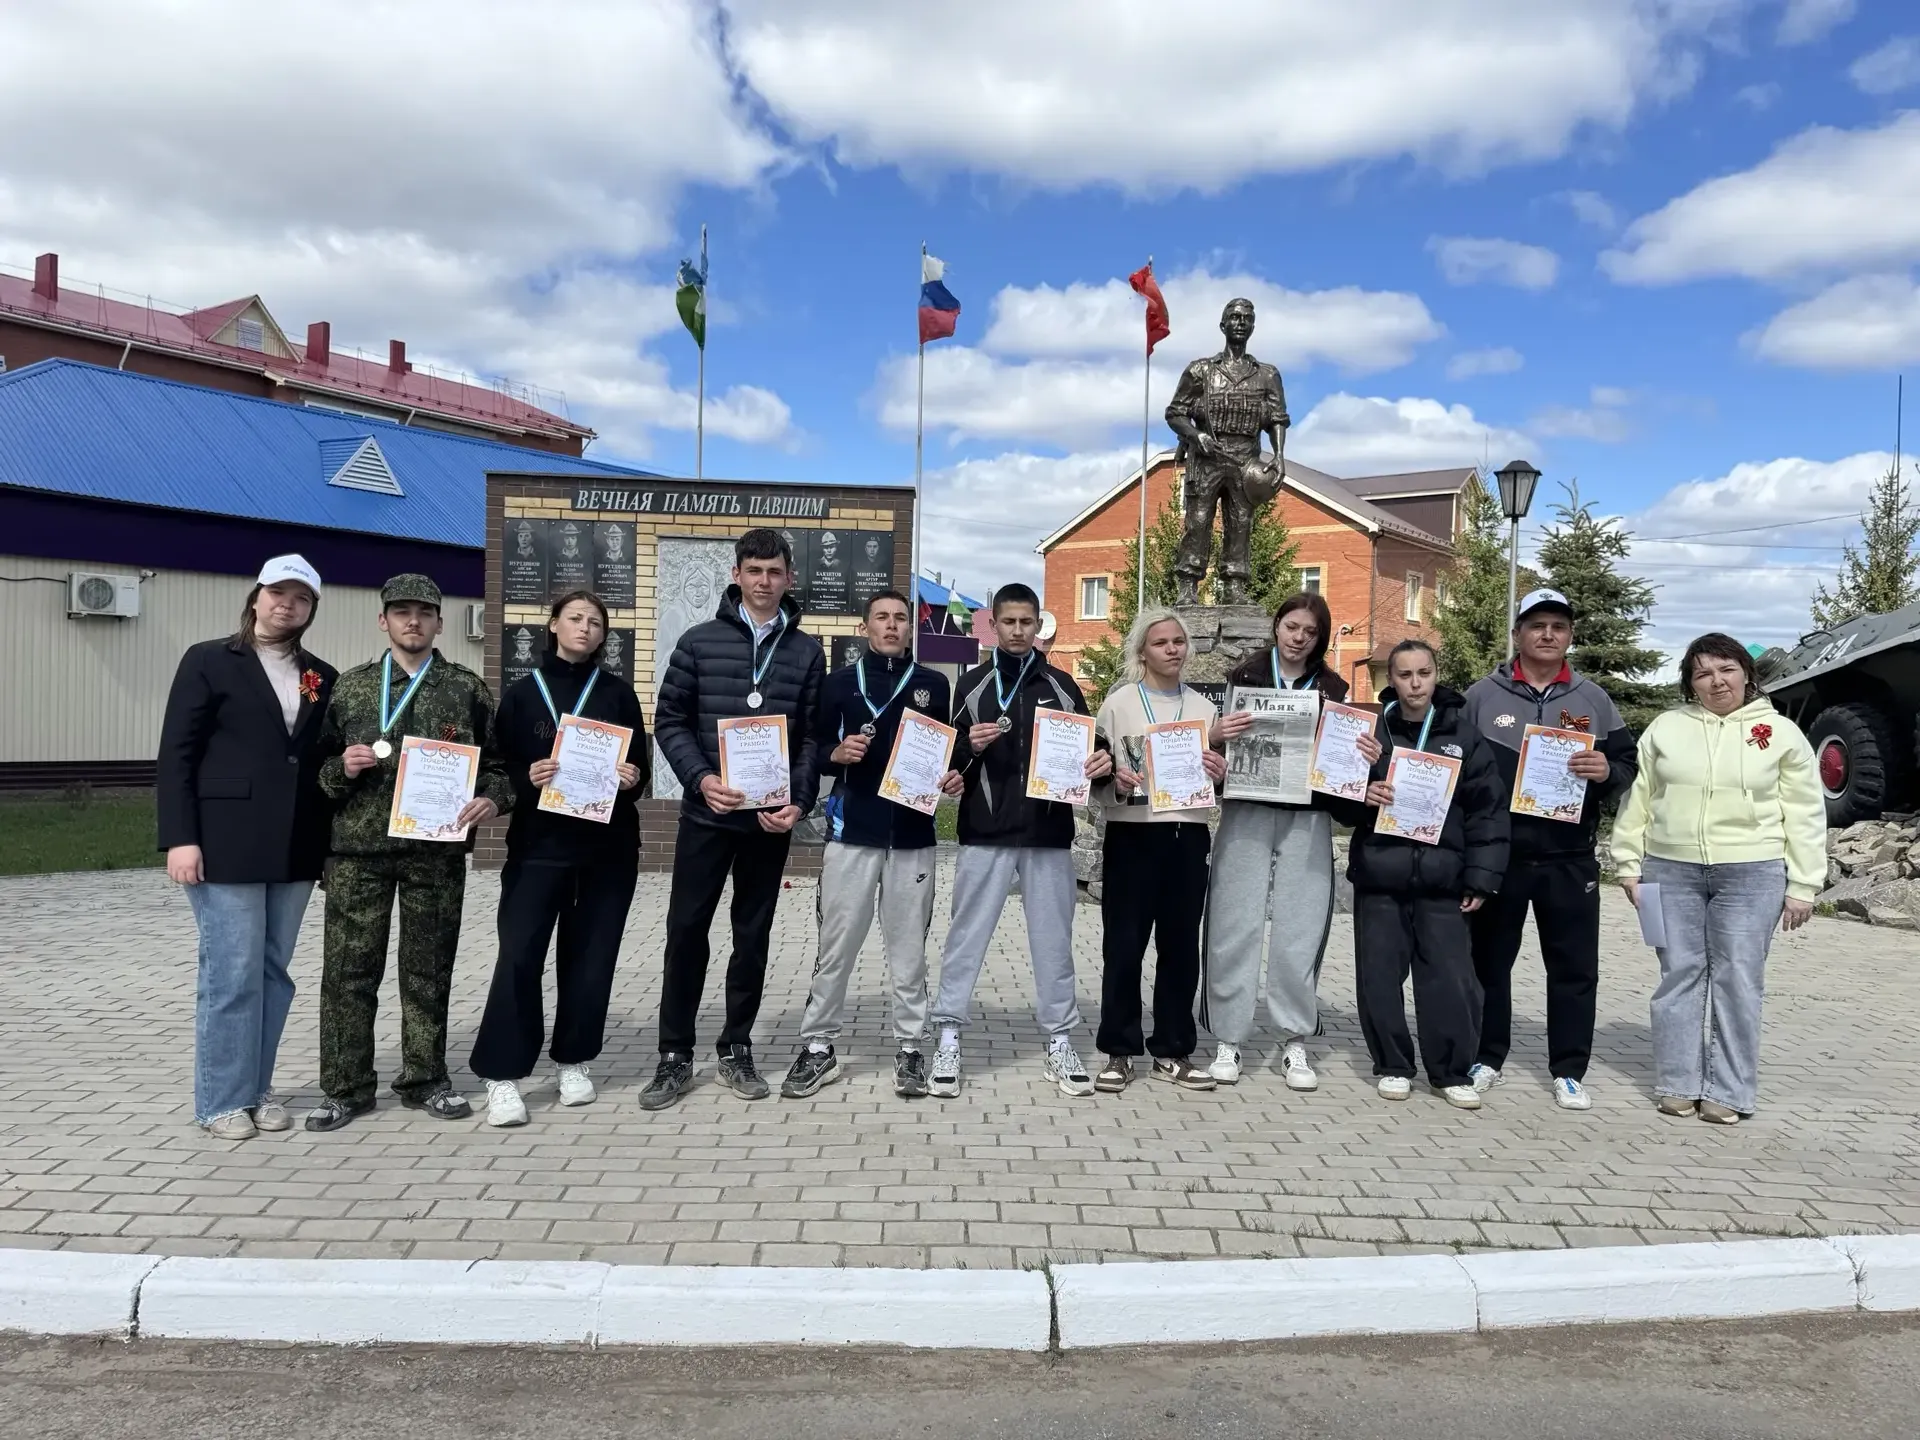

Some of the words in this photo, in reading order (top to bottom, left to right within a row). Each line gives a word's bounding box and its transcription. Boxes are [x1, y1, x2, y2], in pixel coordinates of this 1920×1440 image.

[575, 489, 654, 511] ВЕЧНАЯ
[662, 493, 741, 514] ПАМЯТЬ
[748, 495, 825, 517] ПАВШИМ
[1254, 699, 1295, 712] Маяк
